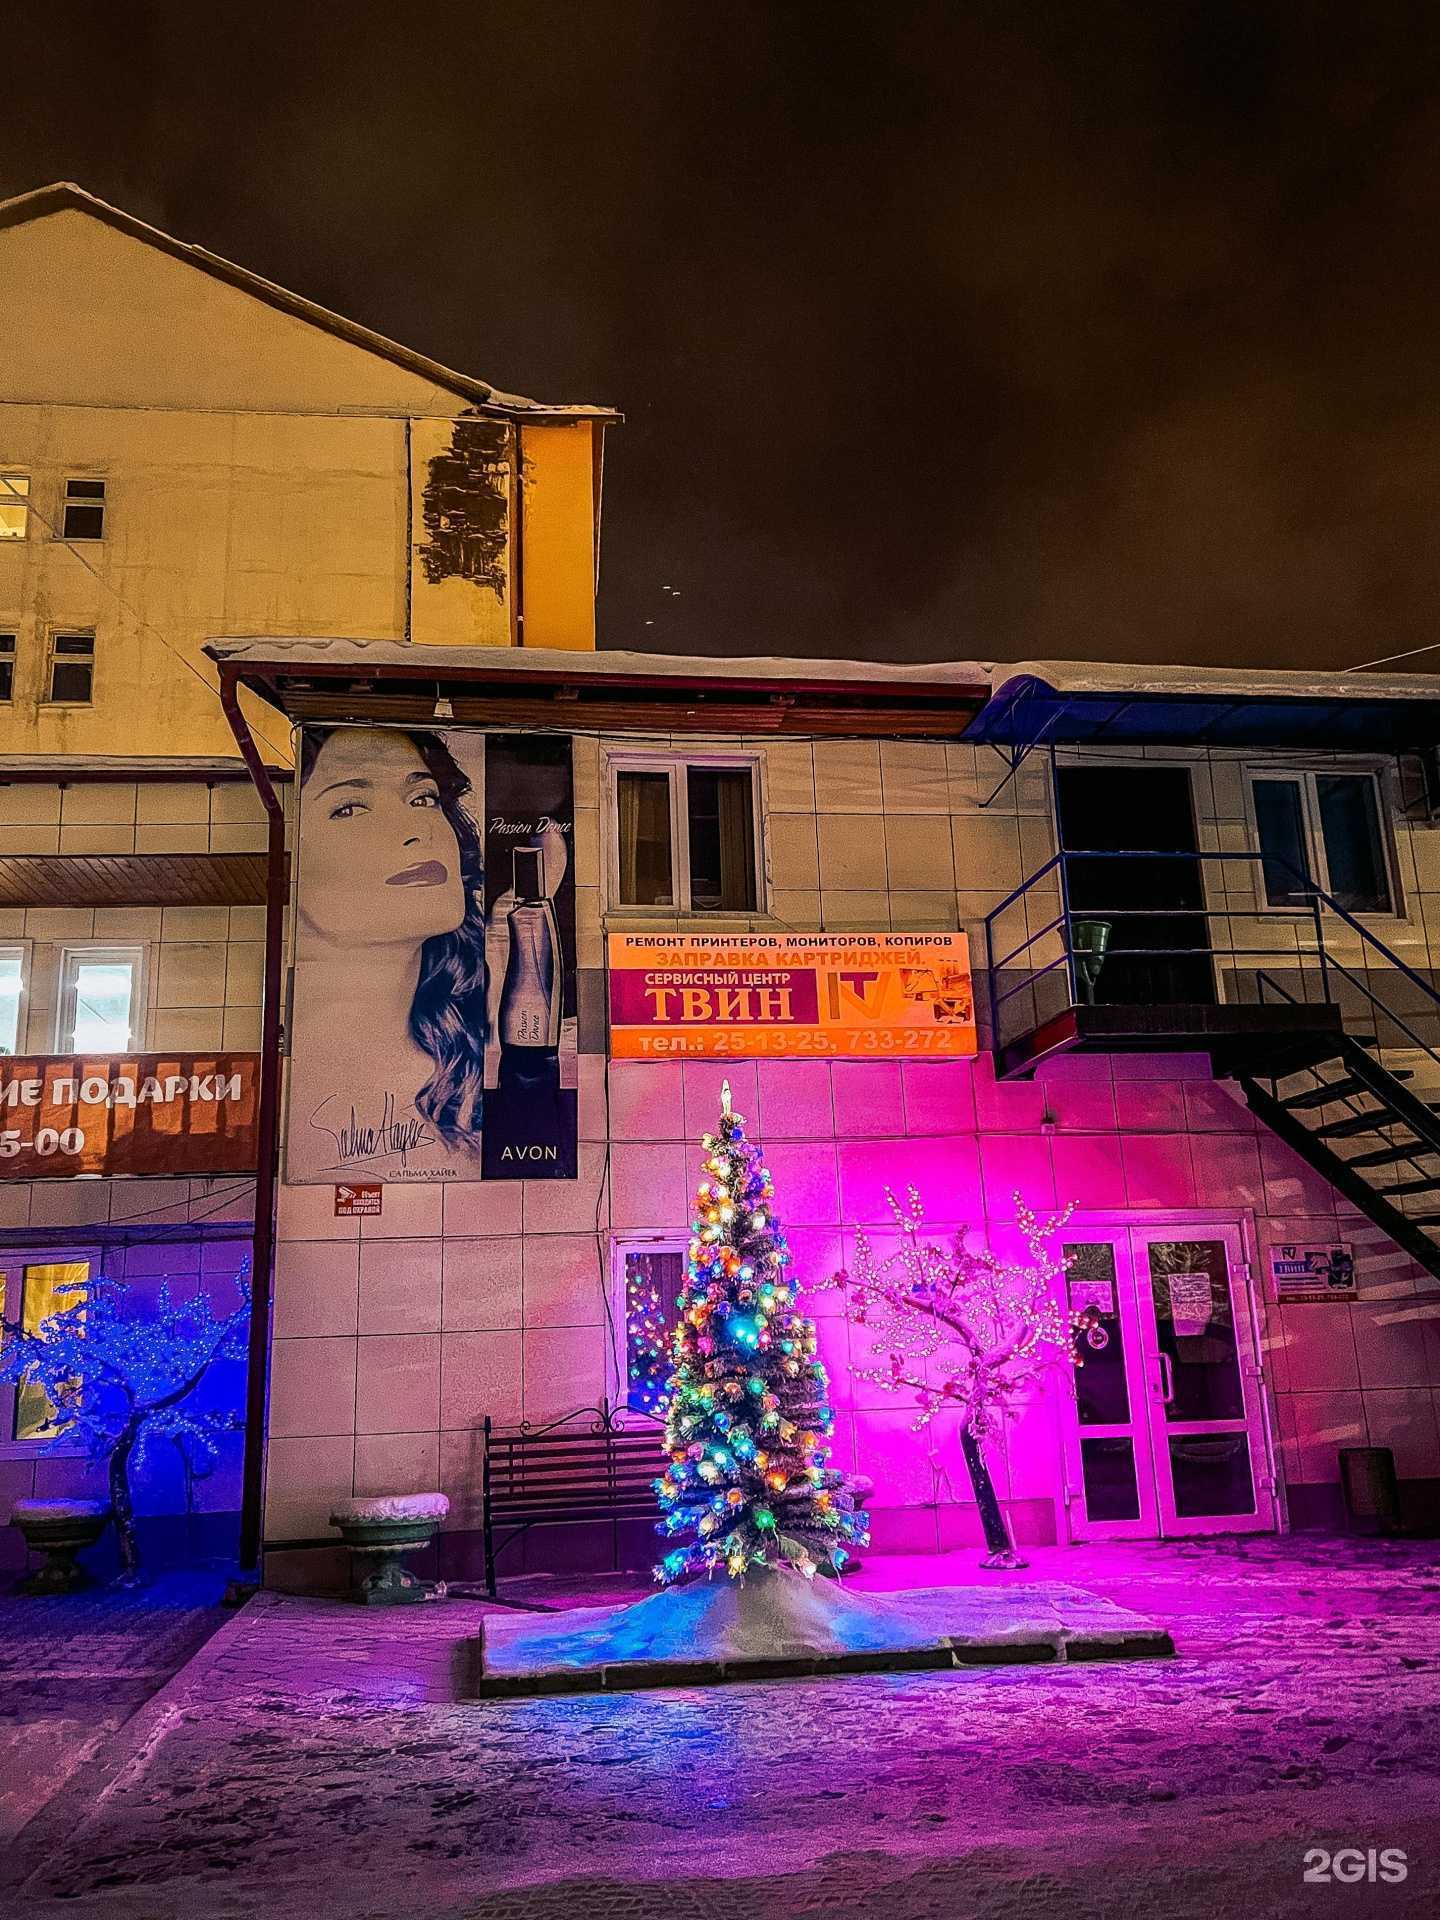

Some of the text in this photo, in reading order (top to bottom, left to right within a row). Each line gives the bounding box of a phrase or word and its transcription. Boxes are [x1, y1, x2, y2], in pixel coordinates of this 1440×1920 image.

[489, 816, 572, 834] Passion Dance
[625, 936, 953, 949] РЕМОНТ ПРИНТЕРОВ, МОНИТОРОВ, КОПИРОВ
[656, 949, 926, 968] ЗАПРАВКА КАРТРИДЖЕЙ.
[644, 971, 791, 987] СЕРВИСНЫЙ ЦЕНТР
[644, 987, 795, 1022] ТВИН
[638, 1030, 953, 1053] тел.: 25-13-25, 733-272
[52, 1074, 242, 1109] ПОДАРКИ
[0, 1127, 85, 1158] 5-00
[500, 1145, 558, 1161] AVON
